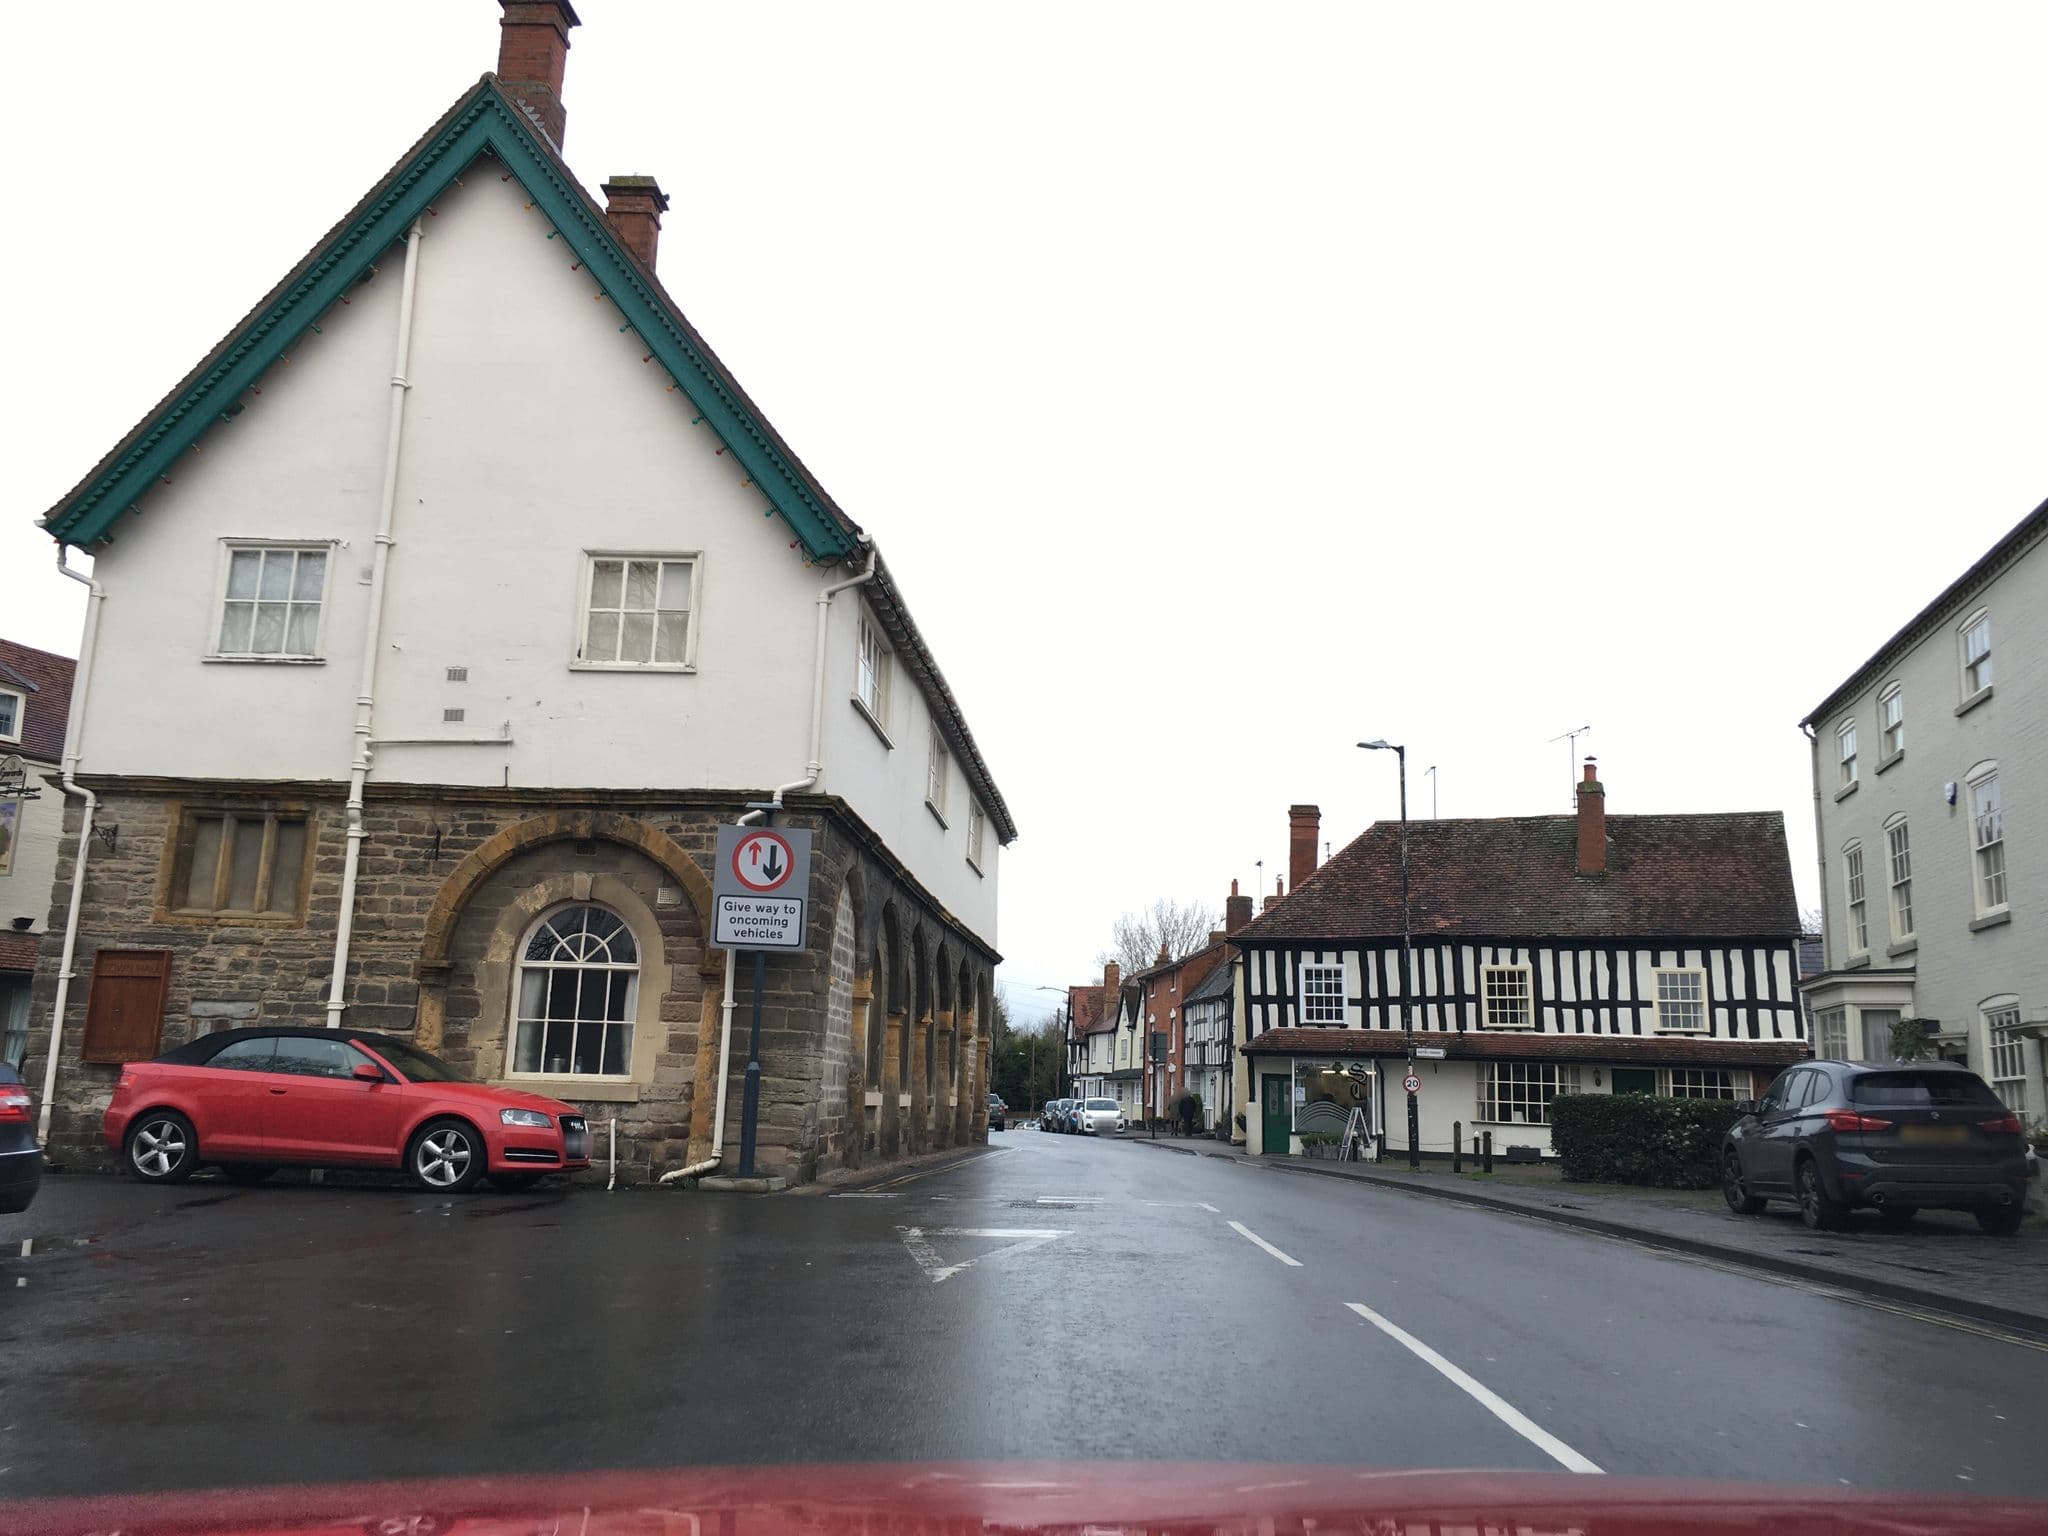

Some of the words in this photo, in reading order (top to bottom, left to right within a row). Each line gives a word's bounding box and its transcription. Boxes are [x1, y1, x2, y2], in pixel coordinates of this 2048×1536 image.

[724, 901, 751, 912] Give
[756, 904, 779, 915] way
[784, 904, 796, 914] to
[729, 916, 788, 928] oncoming
[734, 927, 783, 939] vehicles
[1406, 1079, 1419, 1088] 20
